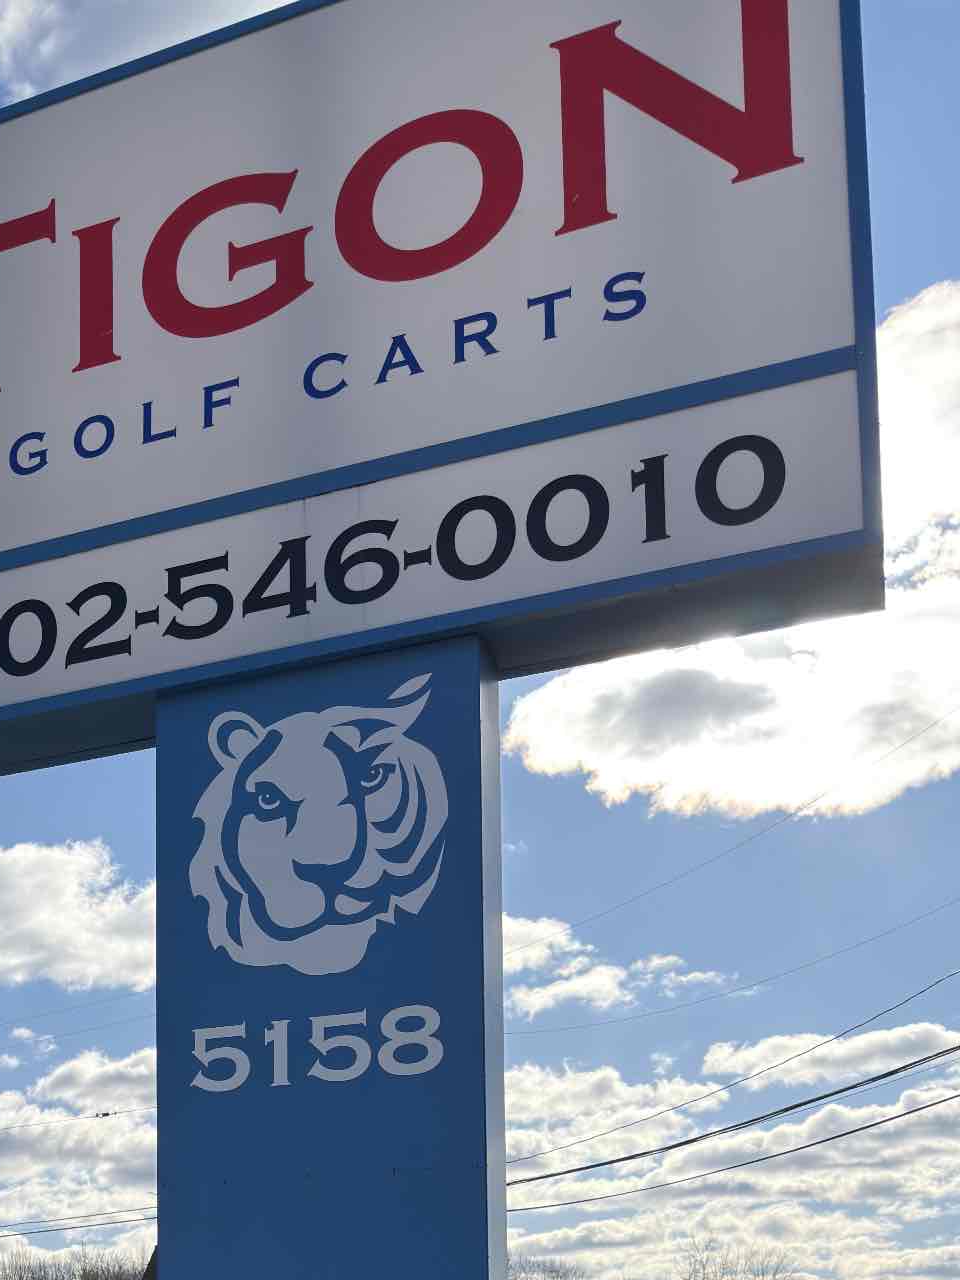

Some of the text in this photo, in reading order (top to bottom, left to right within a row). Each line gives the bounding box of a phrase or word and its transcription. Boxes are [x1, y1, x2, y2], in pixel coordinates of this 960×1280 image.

[9, 270, 648, 476] GOLF CARTS
[190, 1004, 444, 1093] 5158
